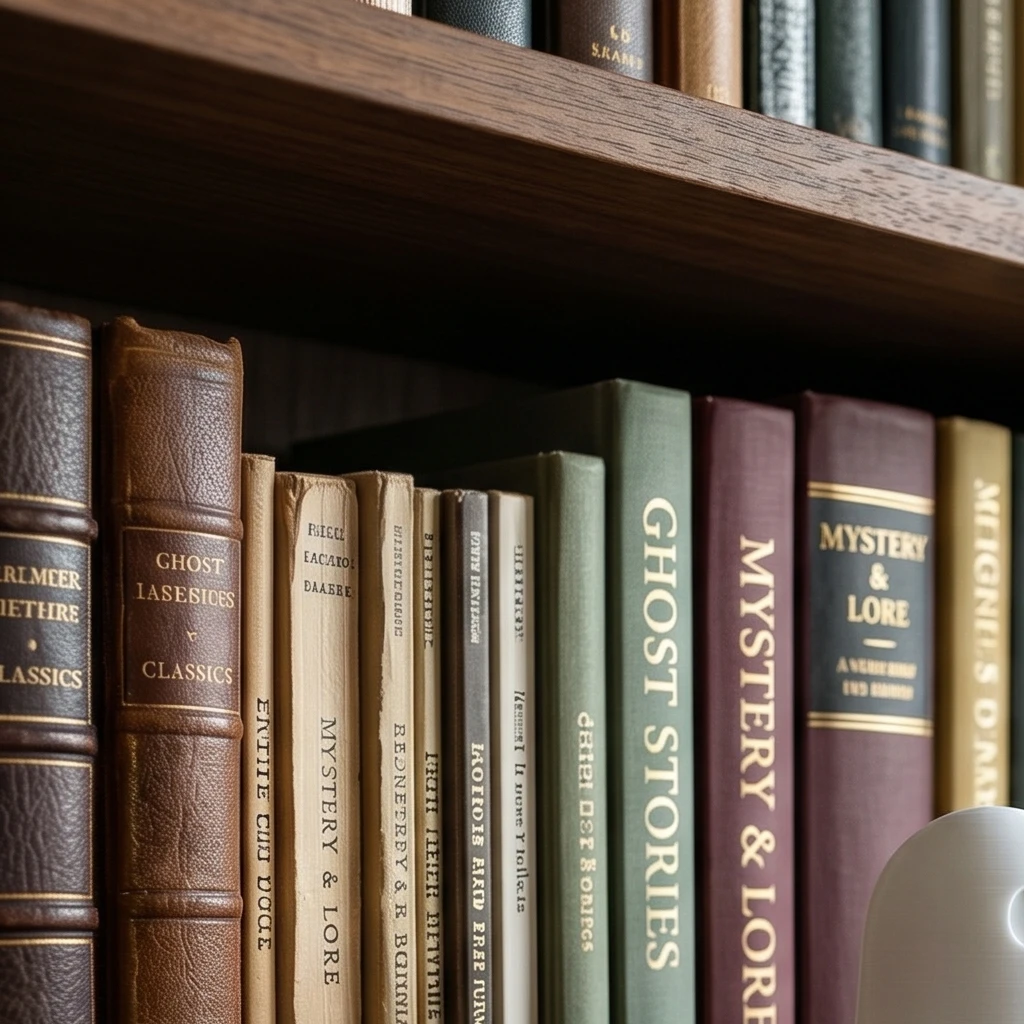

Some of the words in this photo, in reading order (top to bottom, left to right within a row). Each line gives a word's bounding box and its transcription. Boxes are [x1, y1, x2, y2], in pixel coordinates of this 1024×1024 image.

[156, 552, 225, 575] GHOST
[819, 522, 929, 563] MYSTERY
[869, 562, 890, 591] &
[643, 497, 679, 707] GHOST
[847, 594, 910, 628] LORE
[142, 661, 233, 684] CLASSICS
[739, 535, 776, 811] MYSTERY
[321, 717, 339, 854] MYSTERY
[644, 725, 680, 971] STORIES
[740, 824, 777, 868] &
[322, 872, 338, 889] &
[322, 905, 340, 985] LORE
